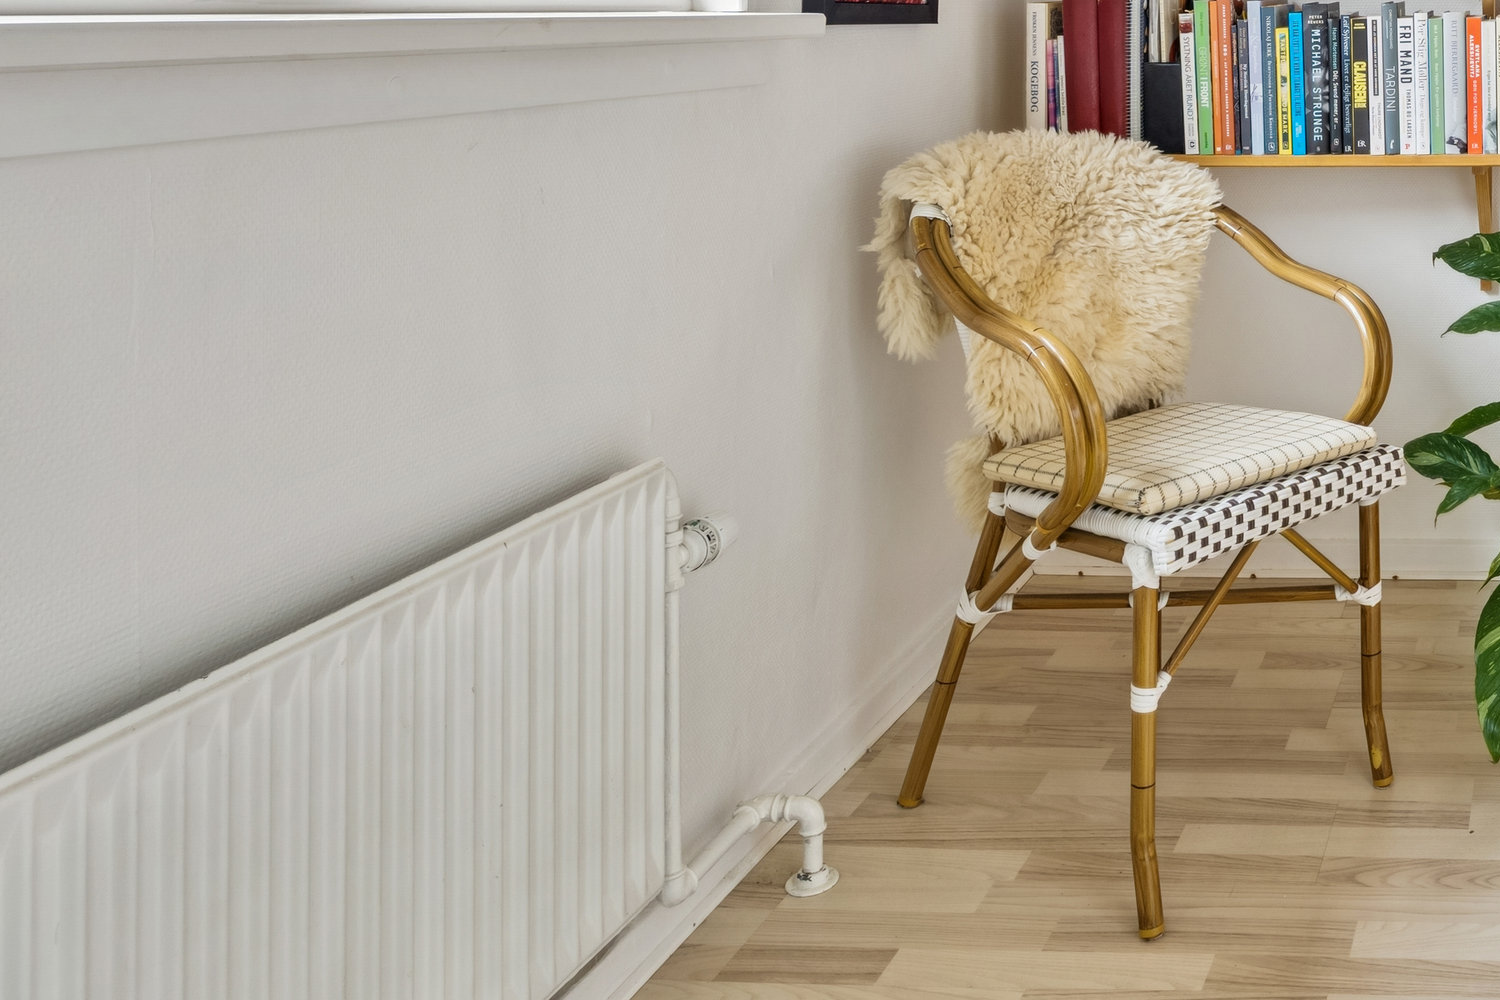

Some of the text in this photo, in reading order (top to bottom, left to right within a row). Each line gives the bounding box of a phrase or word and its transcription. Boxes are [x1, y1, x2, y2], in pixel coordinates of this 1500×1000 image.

[1183, 37, 1191, 73] SYLTNING
[1341, 16, 1350, 56] Leif Sylvester
[1399, 25, 1412, 84] FRI MAND
[1417, 19, 1428, 90] Per Stig Møller
[1030, 61, 1039, 113] KOGEBOG
[1311, 29, 1323, 142] MICHAEL STRUNGE
[1343, 59, 1351, 73] Livet
[1353, 61, 1367, 100] CLAUSEN
[1385, 66, 1395, 112] TARDINI
[1451, 40, 1459, 94] BJERREGAARD
[1200, 81, 1209, 108] FRONT
